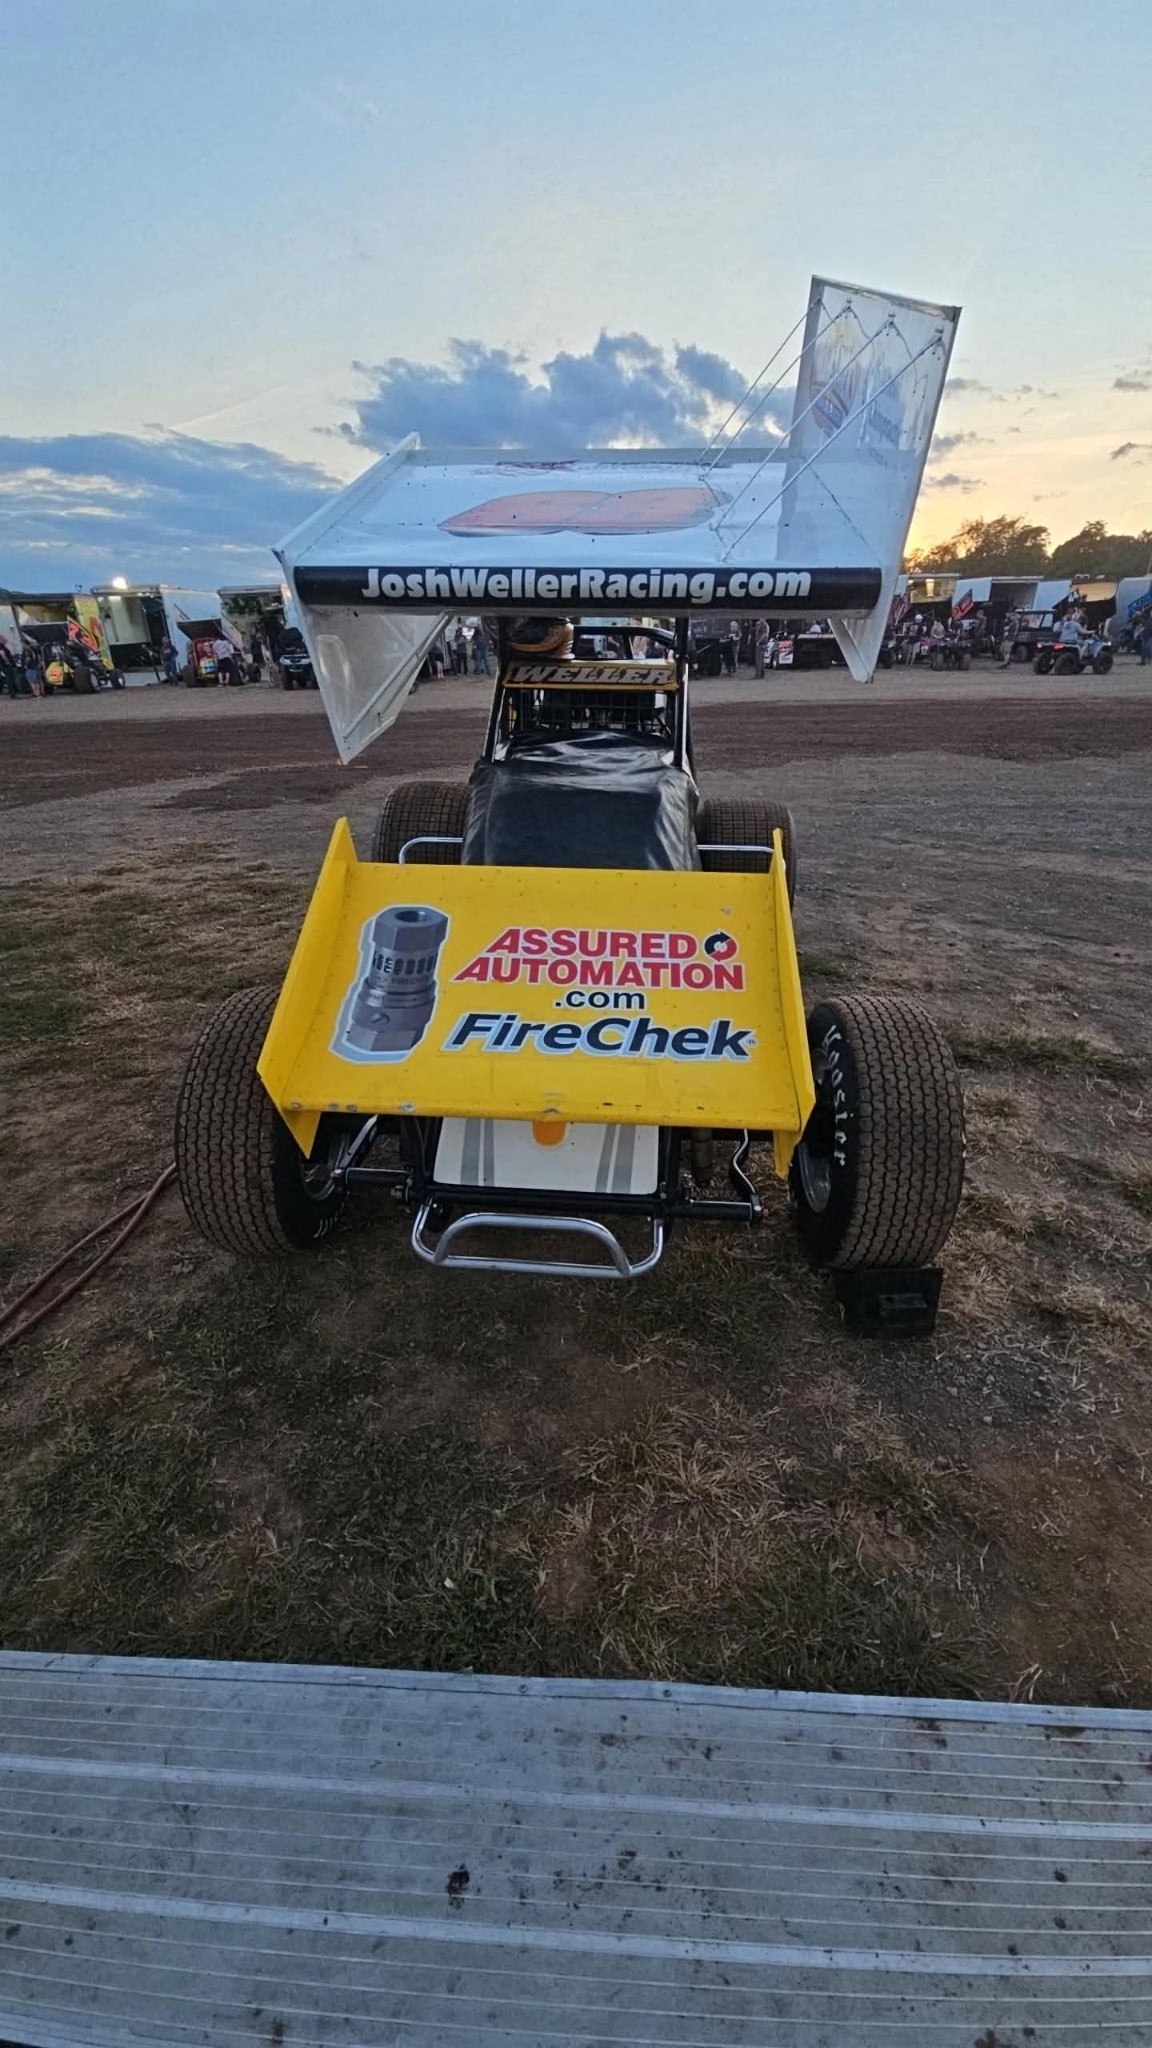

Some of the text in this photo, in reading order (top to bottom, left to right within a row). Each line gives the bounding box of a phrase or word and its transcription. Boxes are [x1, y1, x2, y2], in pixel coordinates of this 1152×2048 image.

[361, 568, 811, 603] JoshWellerRacing.com
[511, 665, 673, 684] WELLER
[486, 928, 698, 960] ASSURED
[452, 957, 744, 990] AUTOMATION
[554, 990, 646, 1010] .com
[451, 1013, 752, 1057] FireChek
[821, 1024, 853, 1167] Hoosier
